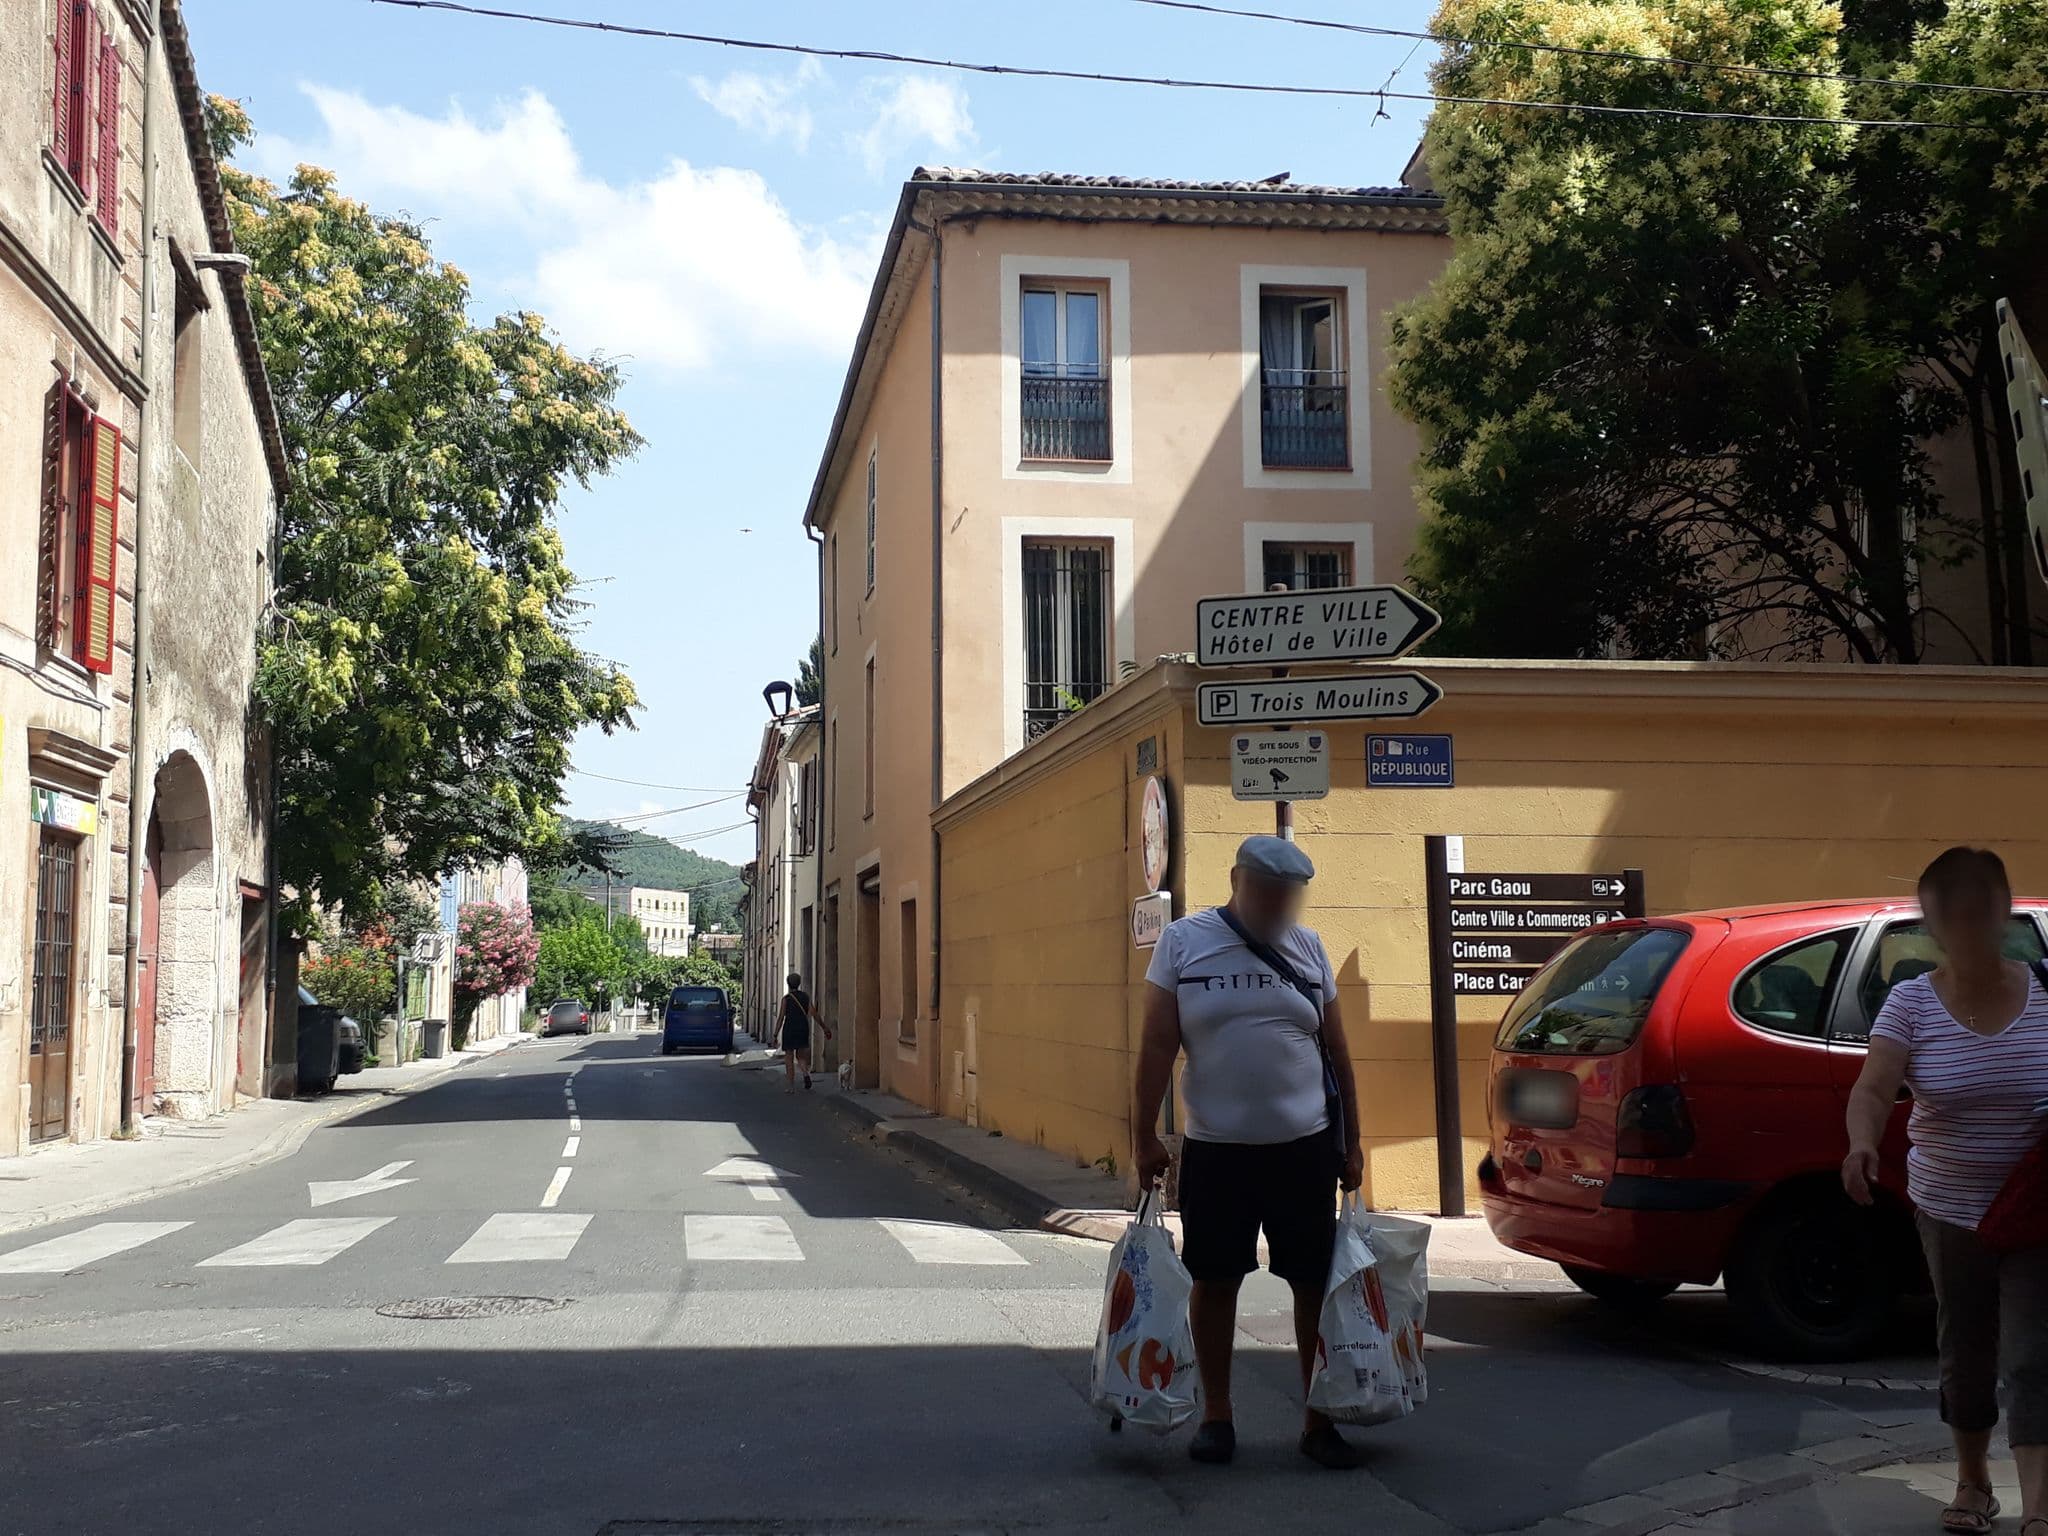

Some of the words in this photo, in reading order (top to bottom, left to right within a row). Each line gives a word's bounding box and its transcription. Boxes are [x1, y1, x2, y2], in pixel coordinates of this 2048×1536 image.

[1211, 605, 1305, 629] CENTRE
[1322, 600, 1388, 623] VILLE
[1210, 633, 1274, 655] Hôtel
[1288, 632, 1315, 651] de
[1333, 627, 1388, 648] Ville
[1216, 694, 1231, 713] P
[1250, 692, 1304, 713] Trois
[1315, 688, 1409, 710] Moulins
[1278, 742, 1300, 750] SOUS
[1406, 743, 1429, 755] Rue
[1242, 756, 1318, 765] VIDÉO-PROTECTION
[1372, 759, 1448, 776] RÉPUBLIQUE
[1450, 878, 1486, 896] Parc
[1491, 878, 1531, 896] Gaou
[1451, 910, 1487, 927] Centre
[1490, 910, 1515, 927] Ville
[1518, 917, 1524, 926] &
[1526, 910, 1591, 927] Commerces
[1453, 941, 1512, 959] Cinéma
[1454, 973, 1494, 990] Place
